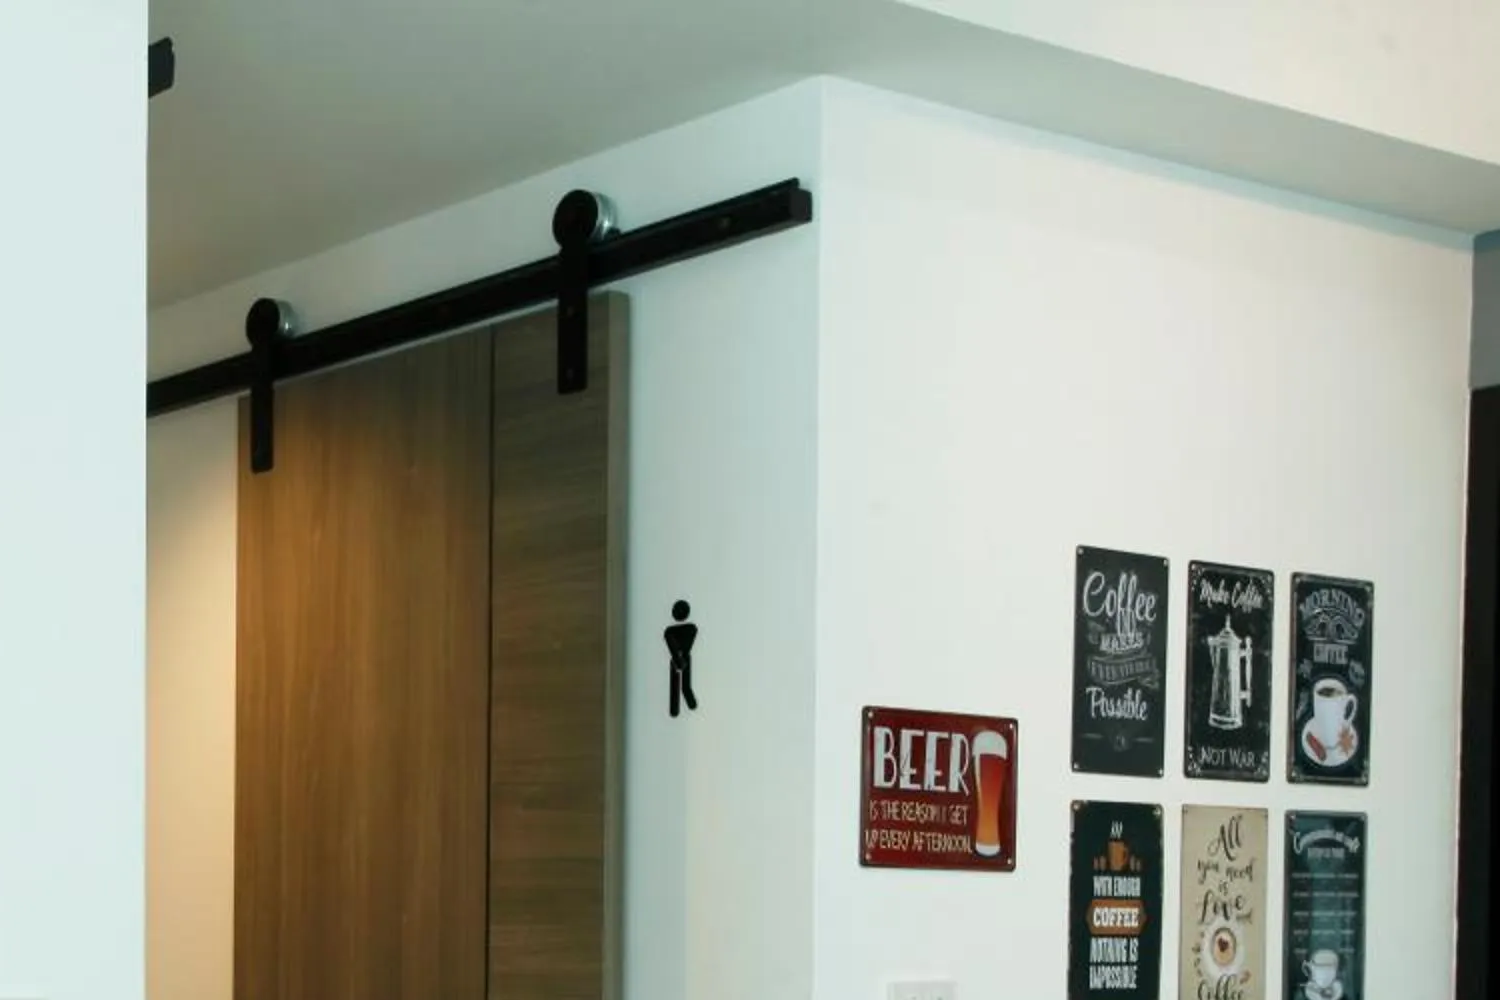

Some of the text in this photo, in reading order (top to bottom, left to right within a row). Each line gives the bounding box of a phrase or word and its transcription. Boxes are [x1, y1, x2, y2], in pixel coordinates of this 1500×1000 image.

[1083, 571, 1156, 638] Coffee
[1085, 687, 1148, 720] Possible
[873, 726, 970, 796] BEER
[1200, 746, 1255, 768] NOT WAR
[869, 799, 878, 821] IS
[880, 800, 901, 822] THE
[902, 801, 940, 825] REASON
[949, 804, 969, 826] GET
[864, 828, 879, 849] UP
[880, 829, 911, 852] EVERY
[1206, 814, 1243, 862] All
[1197, 857, 1257, 885] you need
[1218, 879, 1228, 897] is
[1093, 906, 1139, 928] COFFEE
[1129, 937, 1139, 963] IS
[1089, 965, 1138, 989] IMPOSSIBLE
